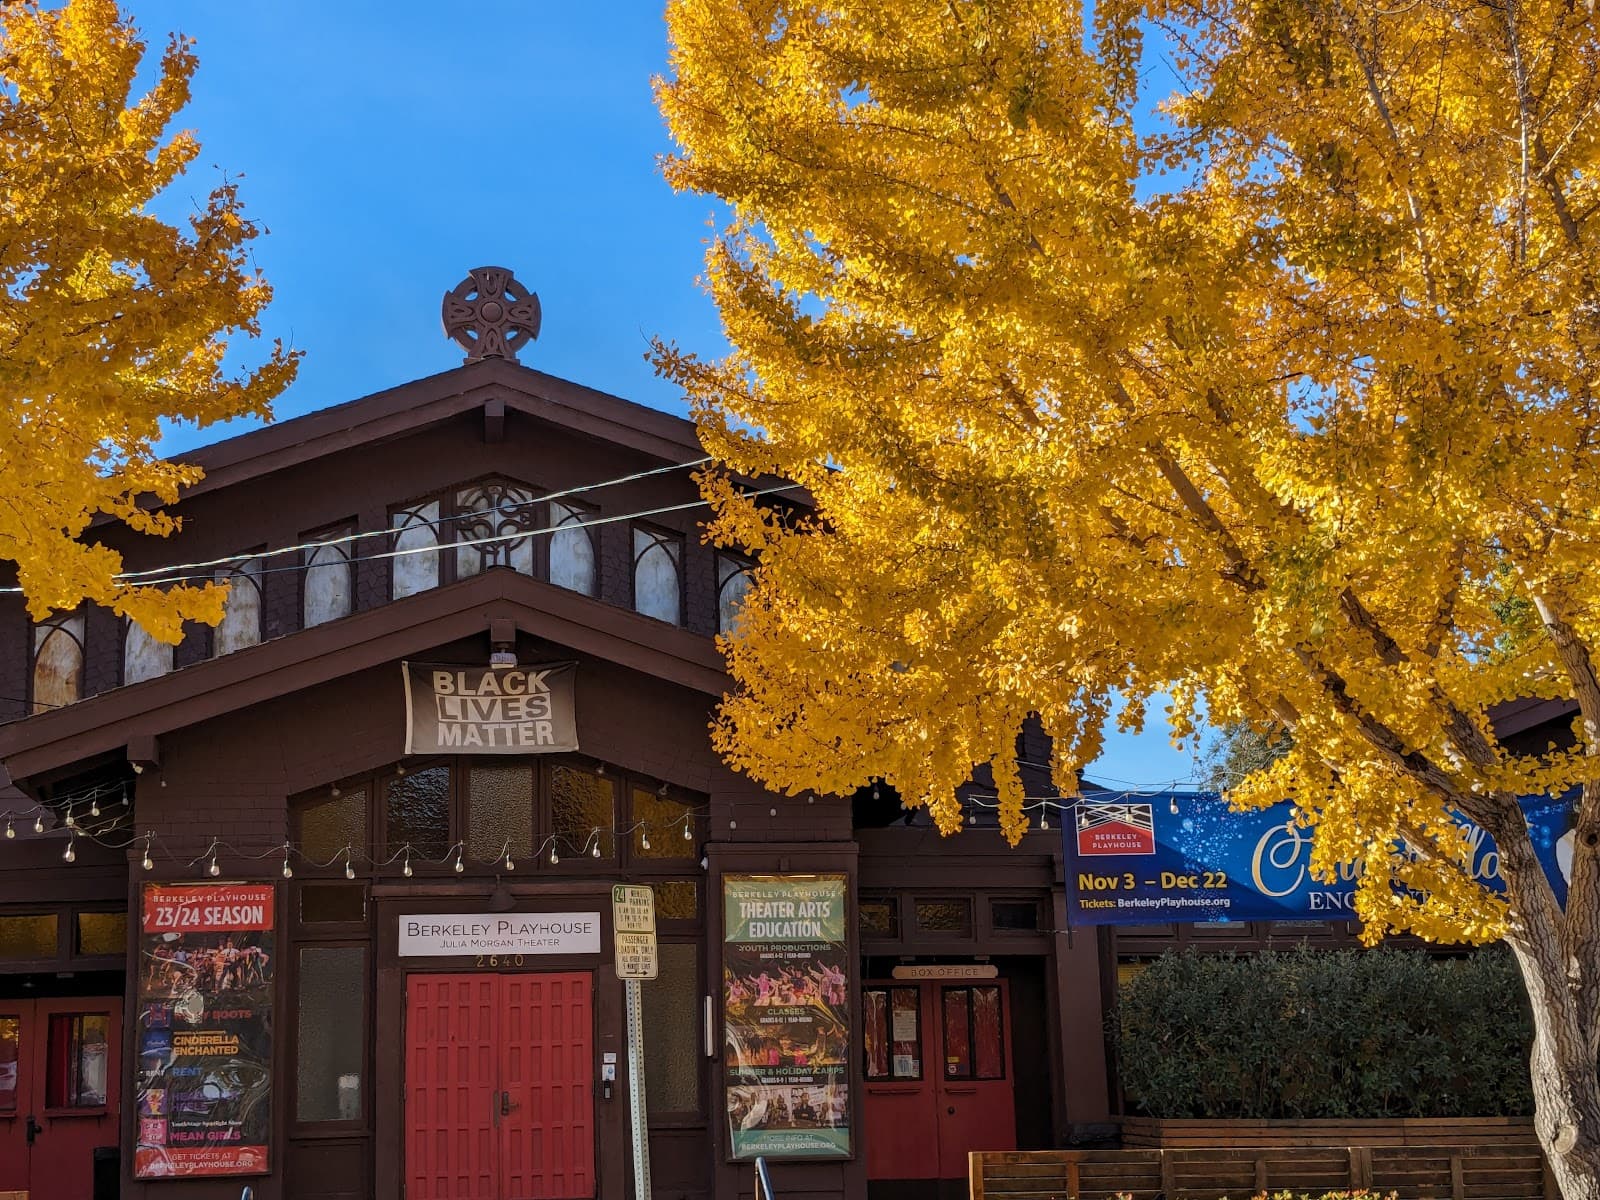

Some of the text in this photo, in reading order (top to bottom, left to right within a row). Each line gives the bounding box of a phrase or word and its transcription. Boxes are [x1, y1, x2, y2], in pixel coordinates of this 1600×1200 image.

[433, 670, 552, 696] BLACK
[438, 696, 550, 721] LIVES
[438, 722, 554, 746] MATTER
[1095, 833, 1138, 841] BERKELEY
[1078, 873, 1118, 891] Nov
[1123, 872, 1136, 890] 3
[1160, 872, 1198, 890] Dec
[1202, 872, 1228, 889] 22
[153, 894, 266, 903] BERKELEY PLAYHOUSE
[616, 888, 625, 902] 24
[782, 890, 836, 898] PLAYHOUSE
[630, 898, 650, 906] PARKING
[1080, 898, 1231, 910] Tickets: BerkeleyPlayhouse.org
[739, 901, 831, 918] THEATER ARTS
[156, 905, 264, 927] 23/24 SEASON
[408, 921, 592, 937] BERKELEY PLAYHOUSE
[749, 922, 821, 938] EDUCATION
[440, 938, 560, 948] JULIA MORGAN THEATER
[622, 935, 648, 944] PASSENGER
[476, 954, 524, 968] 2640
[912, 968, 978, 976] BOX OFFICE
[212, 1010, 252, 1020] BOOTS
[174, 1035, 240, 1046] CINDERELLA
[174, 1046, 239, 1056] ENCHANTED
[172, 1067, 202, 1076] RENT
[776, 1067, 814, 1076] HOLIDAY
[815, 1066, 844, 1074] CAMPS
[170, 1132, 204, 1140] MEAN
[208, 1131, 241, 1140] GIRLS
[742, 1142, 836, 1151] BERKELEYPLAYHOUSE.ORG
